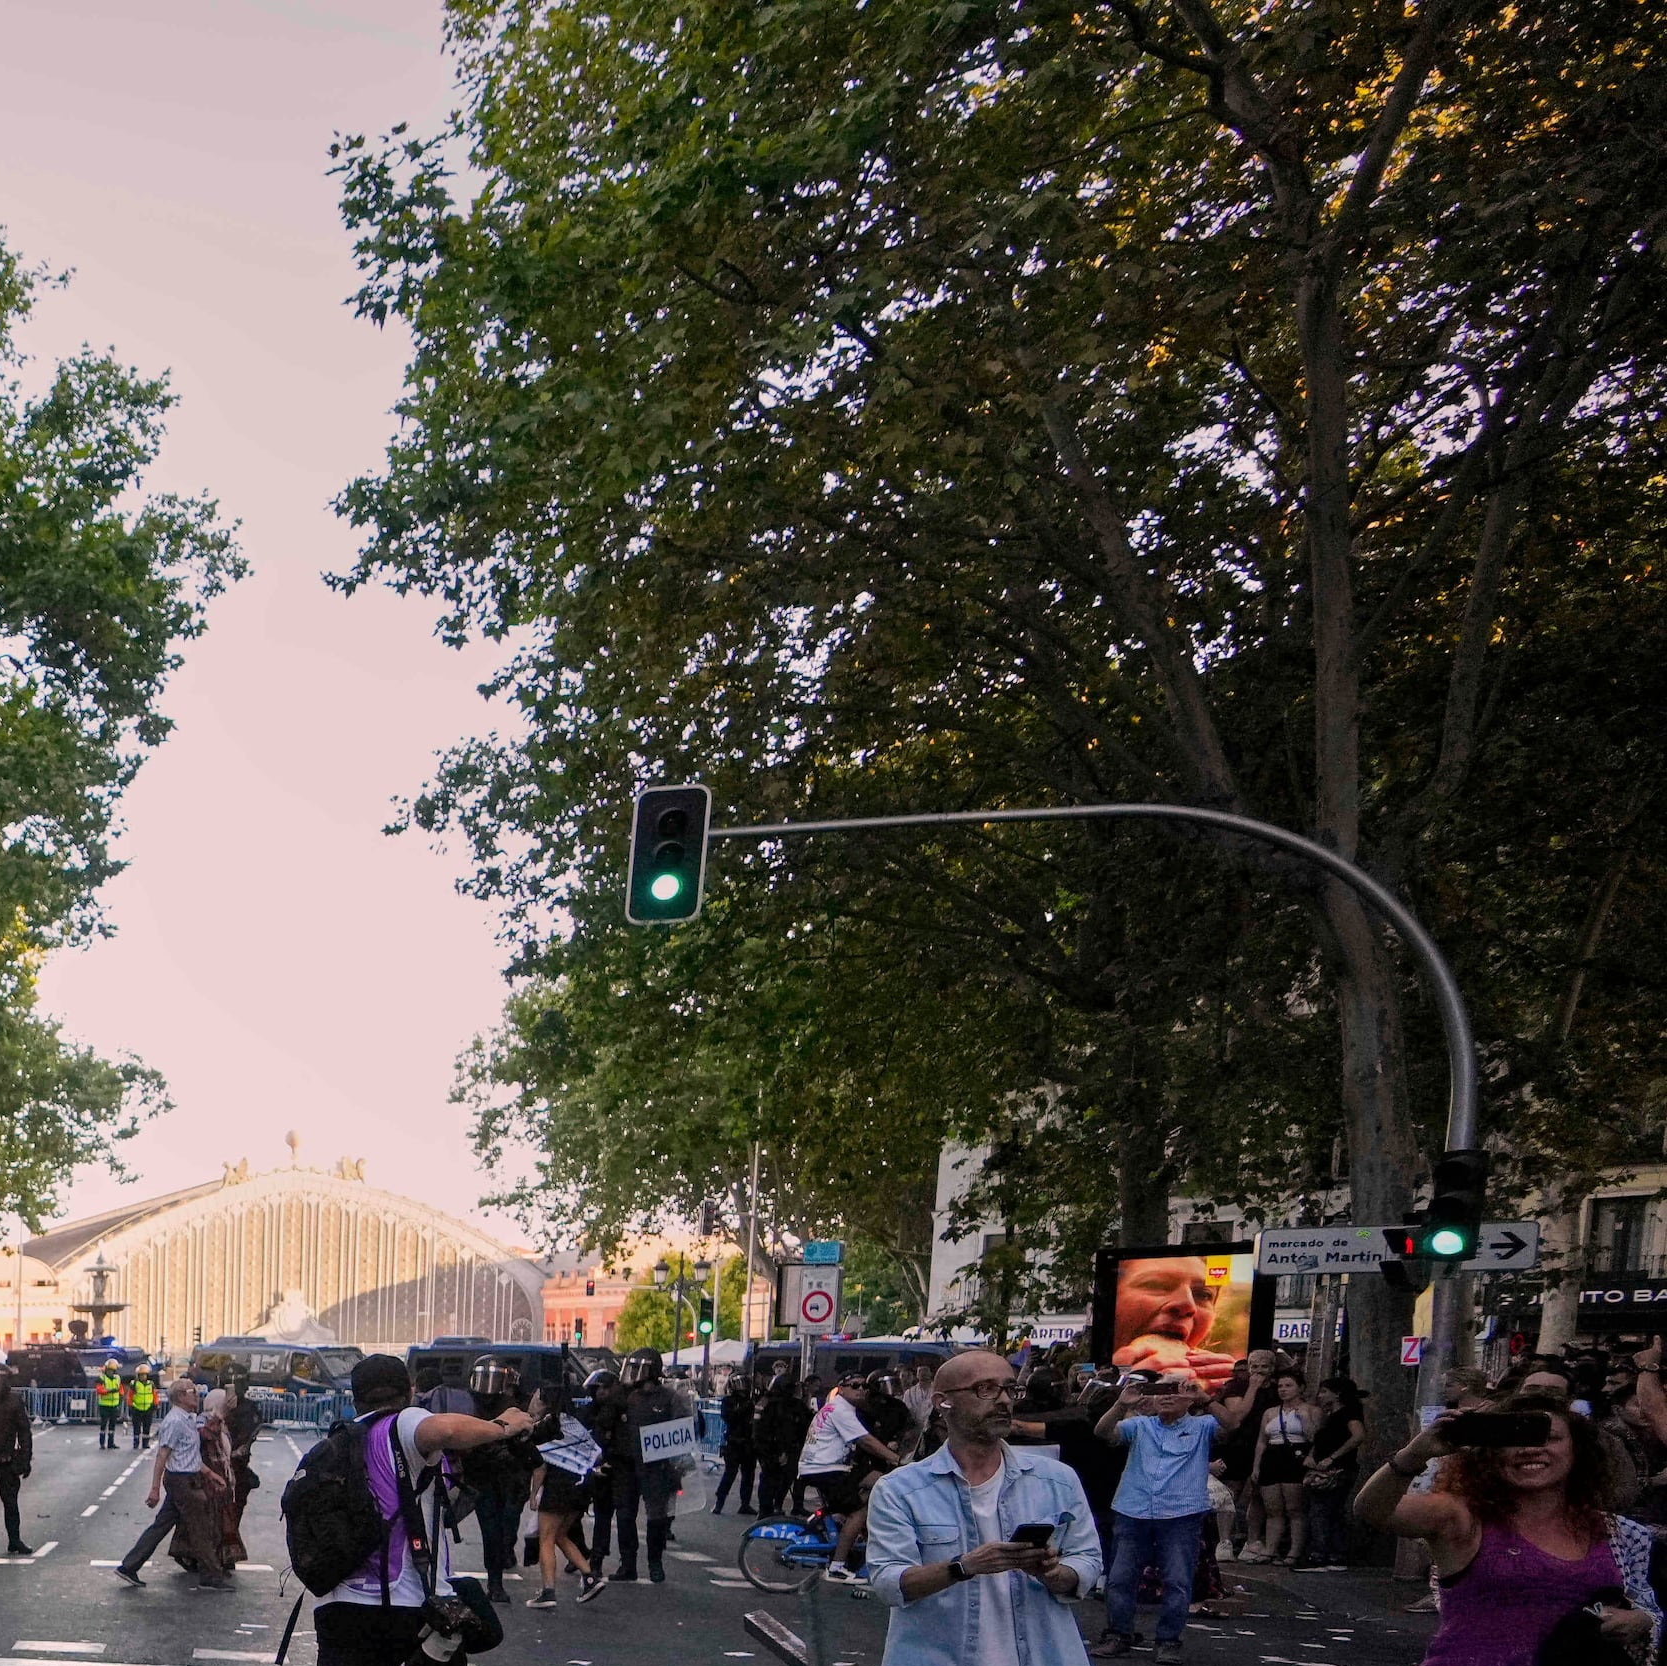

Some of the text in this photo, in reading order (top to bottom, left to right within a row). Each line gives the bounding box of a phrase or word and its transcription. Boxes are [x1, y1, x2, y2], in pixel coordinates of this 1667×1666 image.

[1268, 1239, 1349, 1249] mercado de
[1267, 1250, 1382, 1264] Antó Martín
